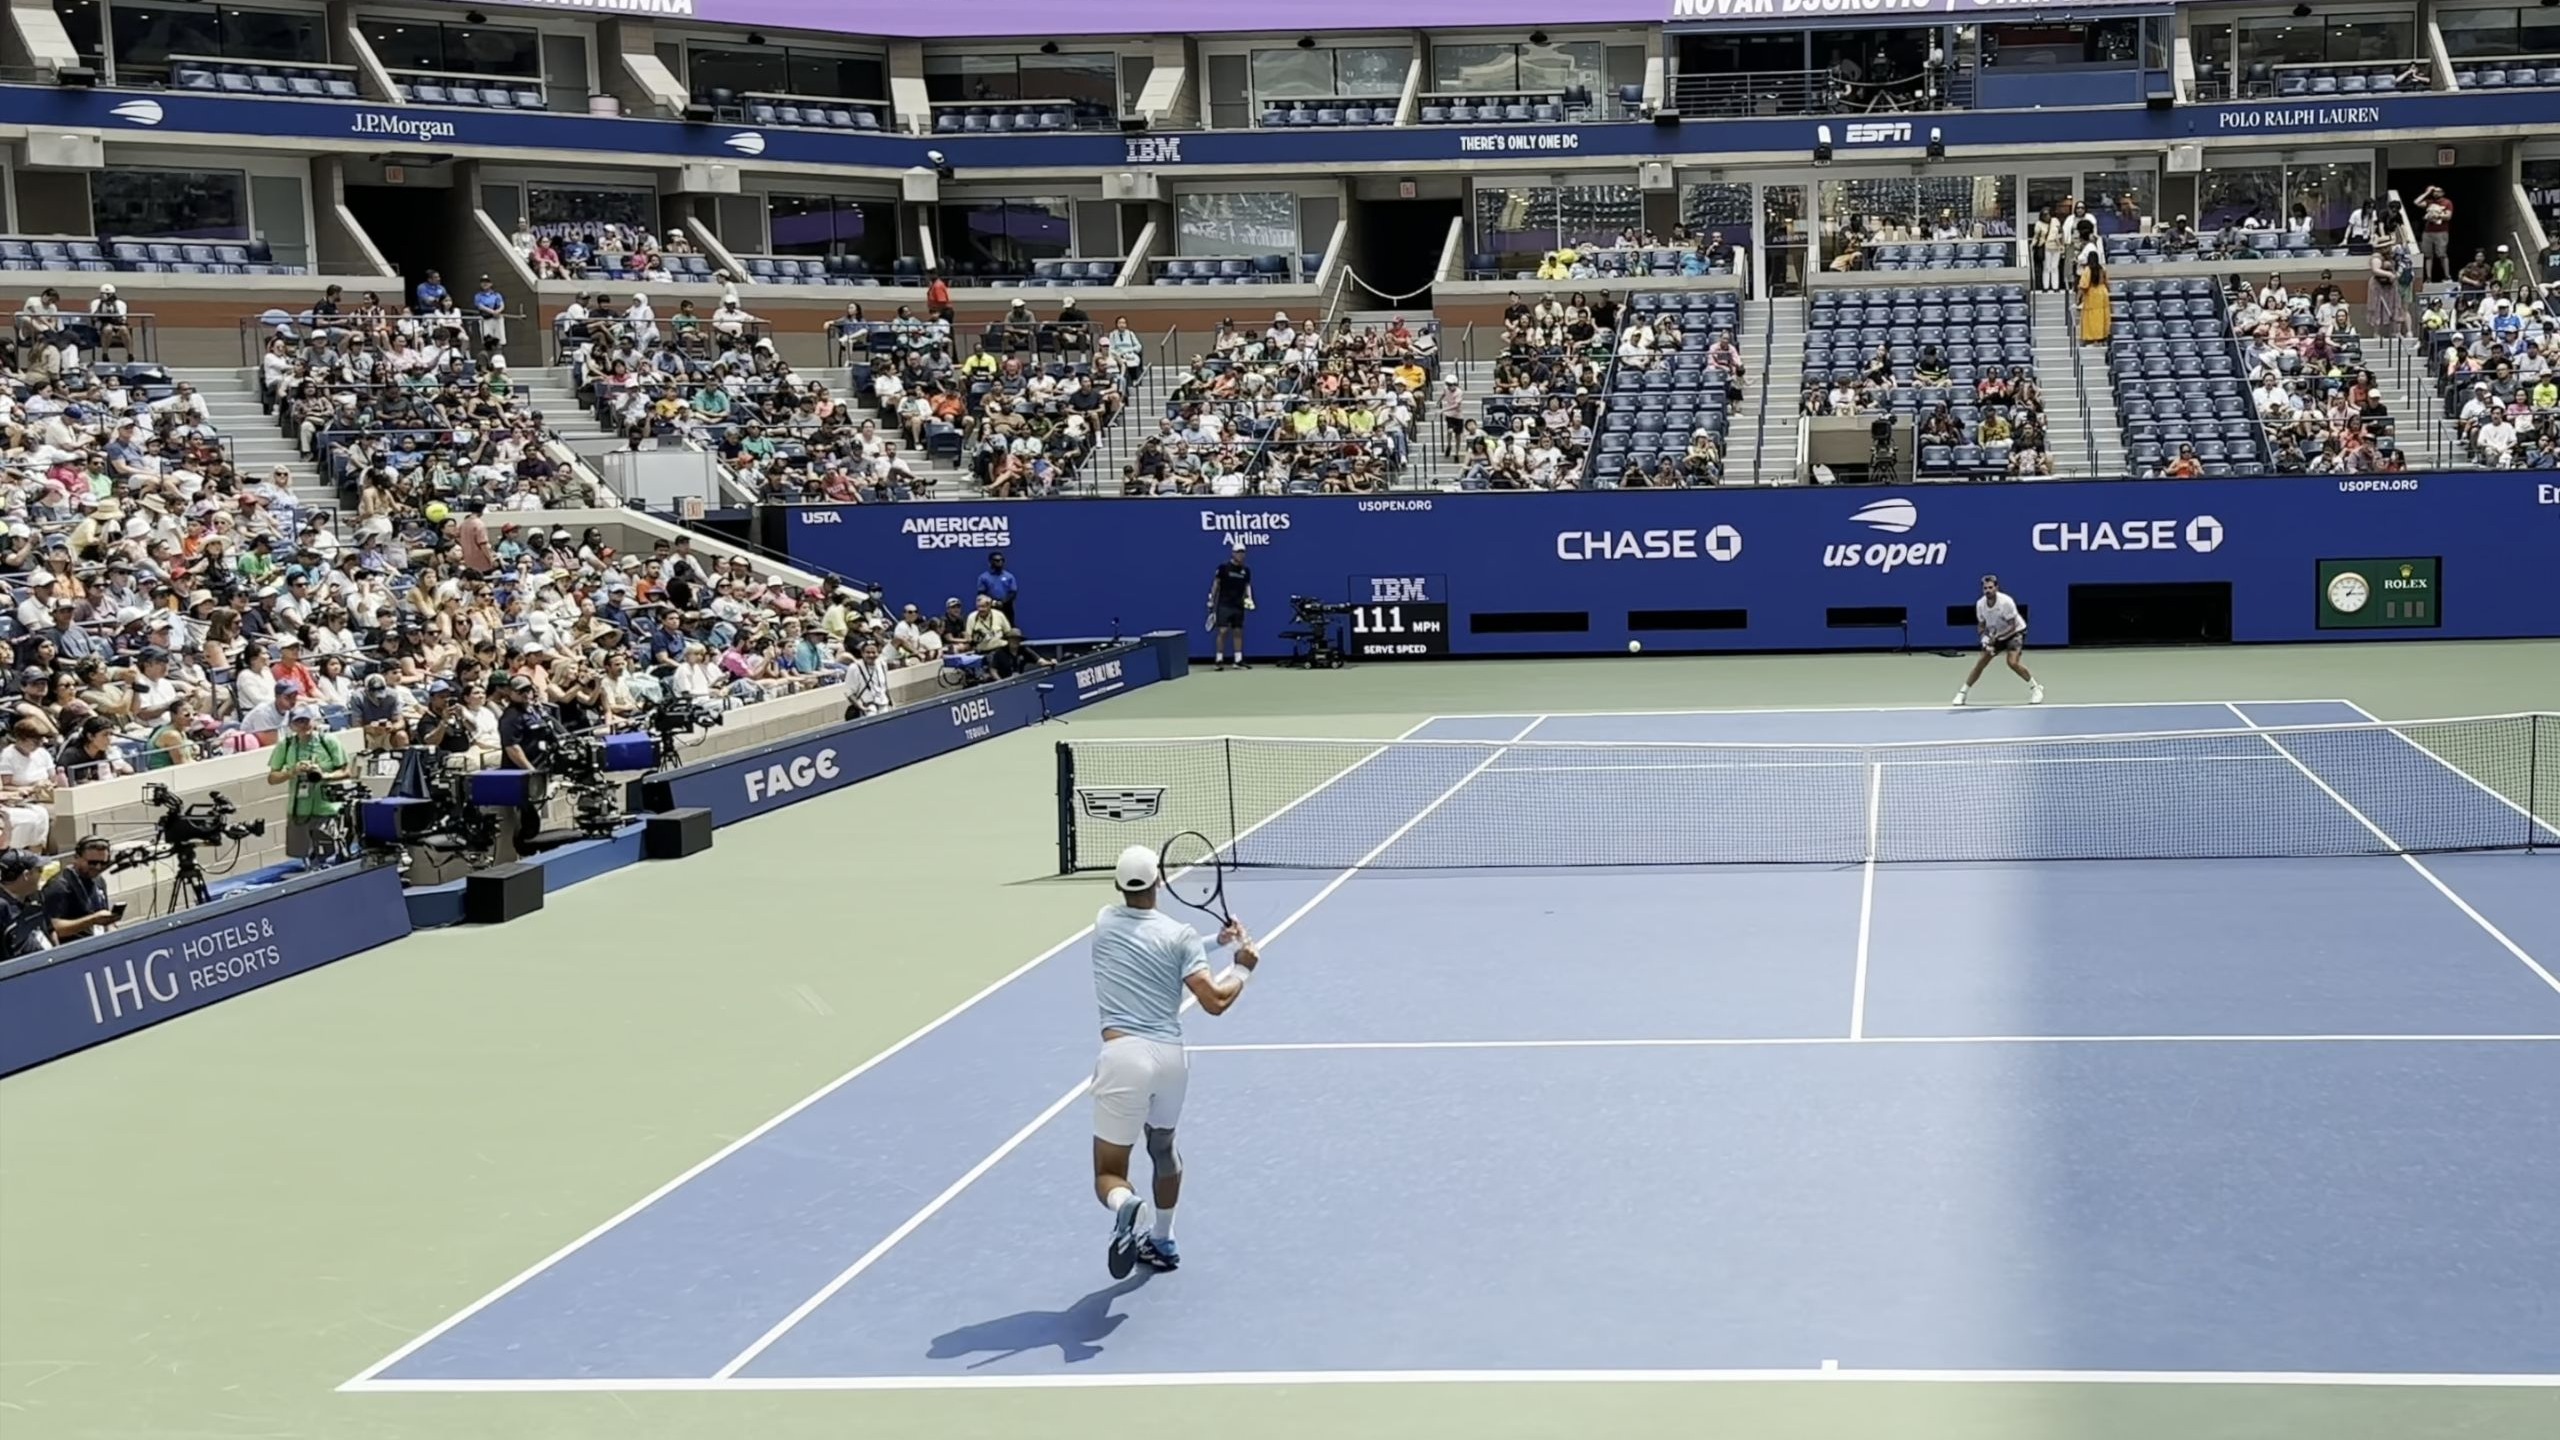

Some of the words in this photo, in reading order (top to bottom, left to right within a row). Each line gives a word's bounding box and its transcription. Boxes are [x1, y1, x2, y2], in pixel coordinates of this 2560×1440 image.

[351, 113, 455, 141] J.P.Morgan
[2219, 111, 2261, 128] POLO
[2264, 109, 2314, 126] RALPH
[2319, 106, 2379, 124] LAUREN
[1460, 134, 1505, 151] THERE'S
[1508, 136, 1537, 150] ONLY
[1538, 135, 1561, 149] ONE
[1562, 134, 1579, 149] DC
[1845, 122, 1912, 143] ESPN
[1126, 137, 1181, 162] IBM
[2339, 479, 2418, 492] USOPEN.ORG
[1358, 500, 1433, 511] USOPEN.ORG
[801, 511, 842, 524] USTA
[901, 516, 1010, 534] AMERICAN
[1200, 510, 1291, 531] Emirates
[917, 532, 1011, 549] EXPRESS
[1557, 529, 1698, 560] CHASE
[2032, 520, 2177, 552] CHASE
[1823, 545, 1862, 567] us
[1864, 542, 1946, 573] open
[1371, 578, 1426, 602] IBM
[2384, 579, 2428, 589] ROLEX
[1353, 606, 1405, 633] 111
[1412, 621, 1440, 633] MPH
[1363, 645, 1395, 655] SERVE
[1396, 644, 1427, 654] SPEED
[951, 697, 995, 727] DOBEL
[182, 921, 259, 963] HOTELS
[261, 917, 275, 938] &
[189, 944, 281, 992] RESORTS
[84, 947, 179, 1024] IHG
